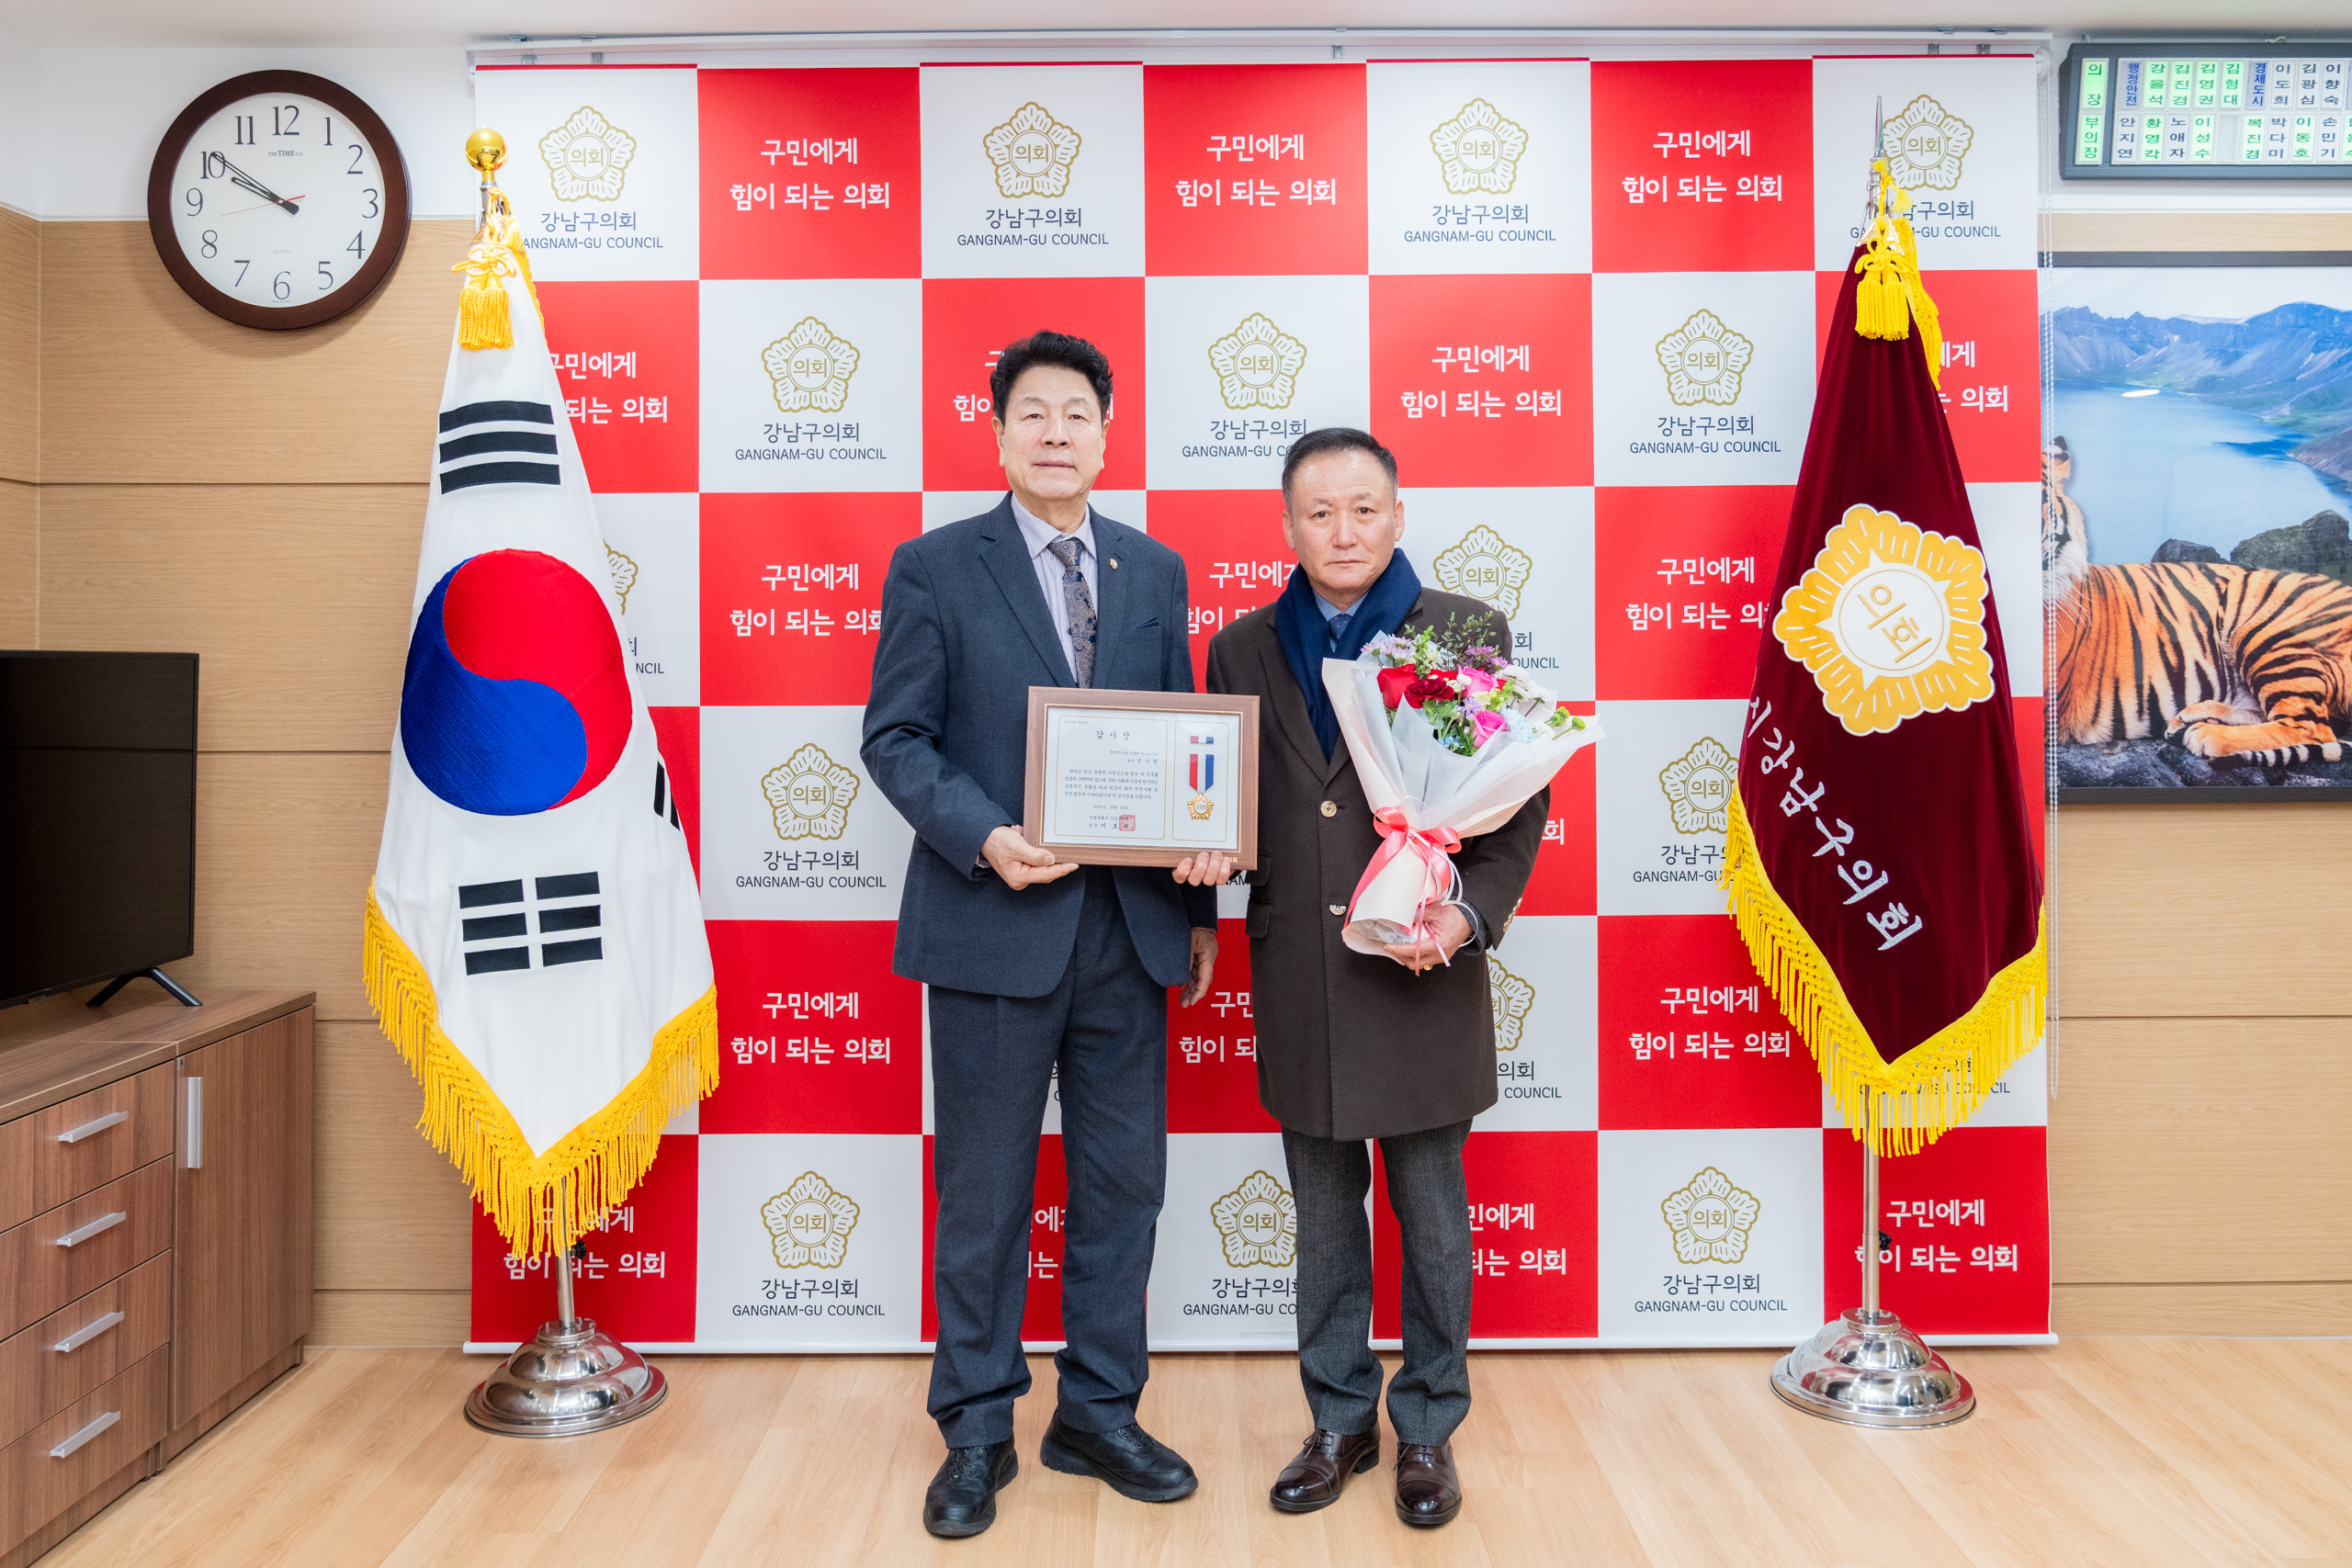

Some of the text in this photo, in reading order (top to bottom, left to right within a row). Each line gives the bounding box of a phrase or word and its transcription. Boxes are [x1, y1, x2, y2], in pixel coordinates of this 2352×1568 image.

[2173, 63, 2190, 106] 김진경
[2199, 62, 2216, 105] 김영권
[2223, 62, 2241, 106] 김형대
[2252, 62, 2267, 106] 경제도시
[2273, 64, 2290, 105] 이도희
[2324, 64, 2340, 105] 이향숙
[235, 116, 255, 145] 11
[272, 106, 300, 136] 12
[324, 117, 334, 146] 1
[761, 138, 857, 165] 구민에게
[1207, 134, 1304, 162] 구민에게
[1462, 141, 1495, 159] 의회
[1654, 130, 1750, 158] 구민에게
[1907, 137, 1940, 155] 의회
[2084, 117, 2100, 160] 부의장
[2117, 118, 2136, 159] 안지연
[2144, 118, 2163, 160] 황영각
[2169, 118, 2187, 159] 노애자
[2194, 117, 2211, 159] 이성수
[2268, 118, 2287, 158] 박다미
[2293, 118, 2311, 158] 이동호
[2321, 118, 2337, 158] 손민기
[200, 152, 225, 179] 10
[347, 144, 363, 175] 2
[571, 148, 603, 166] 의회
[1015, 144, 1048, 163] 의회
[187, 188, 203, 217] 9
[730, 183, 888, 210] 힘이 되는 의회
[1176, 178, 1336, 207] 힘이 되는 의회
[1623, 175, 1781, 203] 힘이 되는 의회
[362, 188, 379, 219] 3
[1432, 204, 1528, 225] 강남구의회
[541, 211, 636, 232] 강남구의회
[986, 208, 1080, 229] 강남구의회
[1945, 226, 2001, 237] COUNCIL
[201, 230, 218, 258] 8
[346, 230, 366, 259] 4
[524, 237, 663, 249] ANGNAM-GU COUNCIL
[958, 233, 1108, 245] GANGNAM-GU COUNCIL
[1405, 231, 1555, 242] GANGNAM-GU COUNCIL
[234, 260, 250, 287] 7
[273, 271, 291, 299] 6
[318, 261, 334, 290] 5
[794, 359, 827, 378] 의회
[1240, 355, 1273, 374] 의회
[1432, 345, 1529, 372] 구민에게
[1687, 352, 1720, 370] 의회
[622, 396, 667, 423] 의회
[1401, 390, 1561, 418] 힘이 되는 의회
[1961, 386, 2007, 412] 의회
[763, 423, 858, 443] 강남구의회
[1210, 419, 1306, 440] 강남구의회
[1657, 415, 1753, 436] 강남구의회
[736, 448, 887, 460] GANGNAM-GU COUNCIL
[1182, 446, 1271, 457] GANGNAM-GU
[1631, 441, 1781, 453] GANGNAM-GU COUNCIL
[762, 564, 858, 591] 구민에게
[1463, 566, 1498, 587] 의회
[1657, 557, 1754, 584] 구민에게
[730, 609, 775, 636] 힘이
[786, 609, 834, 636] 되는
[1626, 602, 1770, 630] 힘이 되는 의
[1858, 583, 1932, 663] 의회
[636, 662, 665, 674] NCIL
[1512, 657, 1560, 669] OUNCIL
[793, 785, 826, 805] 의회
[1689, 778, 1724, 798] 의회
[1542, 818, 1565, 845] 회
[763, 851, 858, 871] 강남구의회
[736, 876, 887, 887] GANGNAM-GU COUNCIL
[763, 992, 858, 1019] 구민에게
[1661, 987, 1758, 1014] 구민에게
[731, 1036, 889, 1064] 힘이 되는 의회
[1180, 1035, 1257, 1063] 힘이 되
[1629, 1031, 1790, 1060] 힘이 되는 의회
[1505, 1088, 1561, 1098] COUNCIL
[793, 1213, 826, 1233] 의회
[1243, 1213, 1276, 1232] 의회
[1468, 1203, 1534, 1231] 민에게
[1693, 1210, 1726, 1228] 의회
[1886, 1199, 1984, 1227] 구민에게
[618, 1251, 664, 1278] 의회
[1028, 1251, 1058, 1279] 는
[1520, 1248, 1566, 1275] 의회
[1910, 1245, 1961, 1272] 되는
[1970, 1245, 2017, 1271] 의회
[762, 1279, 857, 1299] 강남구의회
[1664, 1274, 1759, 1295] 강남구의회
[733, 1305, 885, 1315] GANGNAM-GU COUNCIL
[1183, 1304, 1273, 1314] GANGNAM-GU
[1635, 1300, 1787, 1312] GANGNAM-GU COUNCIL
